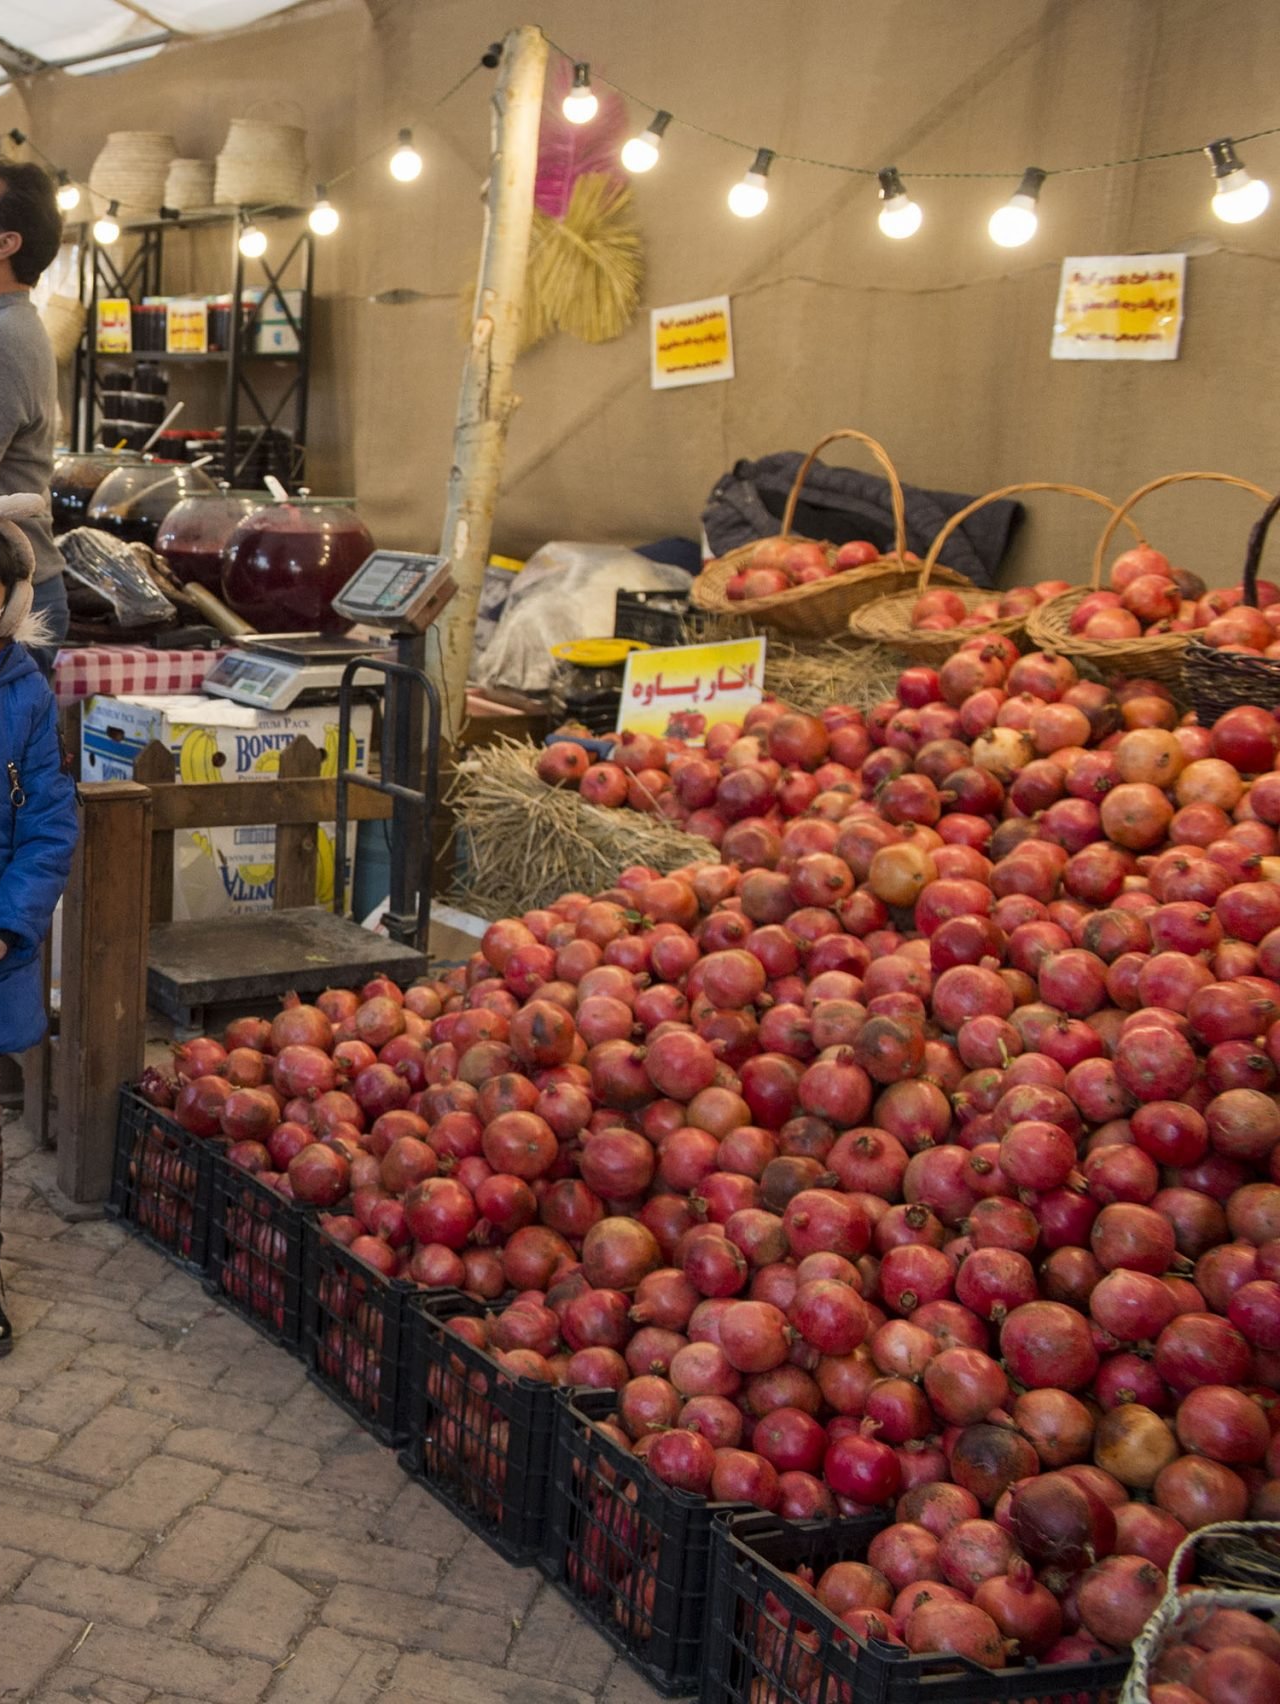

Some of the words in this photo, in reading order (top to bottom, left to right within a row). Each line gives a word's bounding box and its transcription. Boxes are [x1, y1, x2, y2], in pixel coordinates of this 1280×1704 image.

[632, 673, 699, 705] پاوه
[704, 664, 754, 701] انار
[235, 734, 294, 772] BONIT
